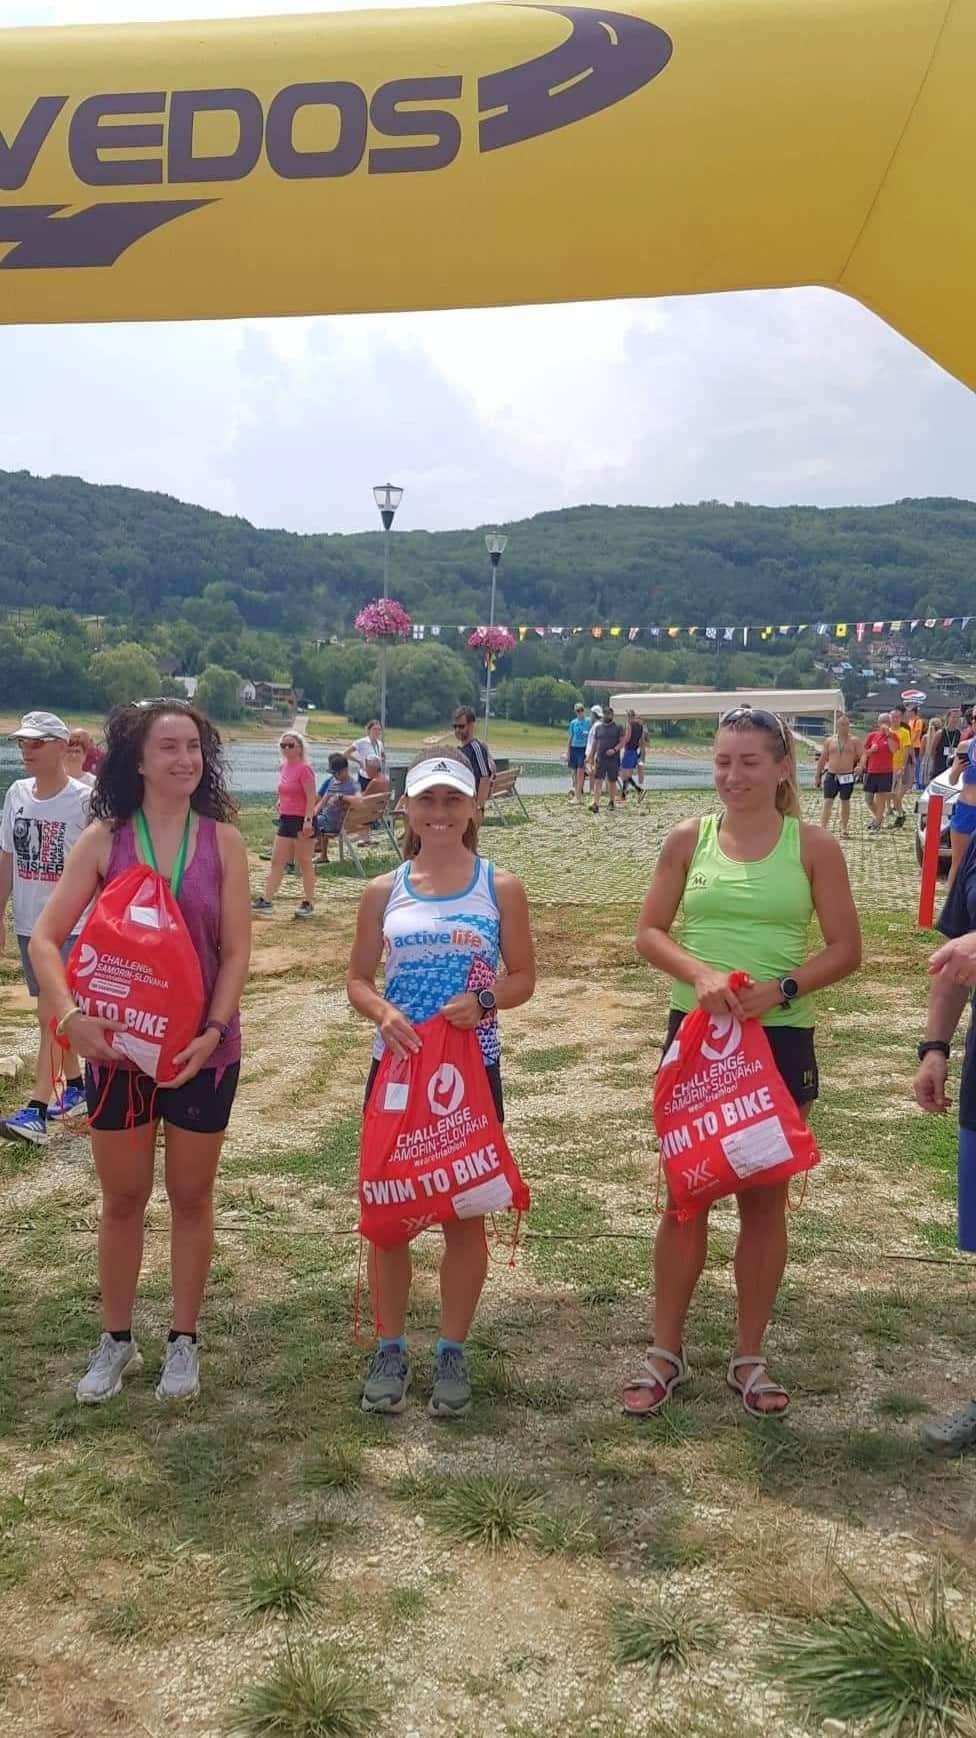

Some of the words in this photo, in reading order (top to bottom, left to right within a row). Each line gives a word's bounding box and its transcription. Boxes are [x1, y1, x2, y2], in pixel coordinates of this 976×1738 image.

[394, 928, 482, 948] activelife
[100, 954, 154, 975] CHALLENGE
[125, 1007, 169, 1038] BIKE
[396, 1107, 472, 1148] CHALLENGE
[693, 1111, 719, 1141] TO
[721, 1086, 775, 1127] BIKE
[362, 1177, 417, 1205] SWIM
[418, 1167, 451, 1197] TO
[452, 1143, 500, 1185] BIKE
